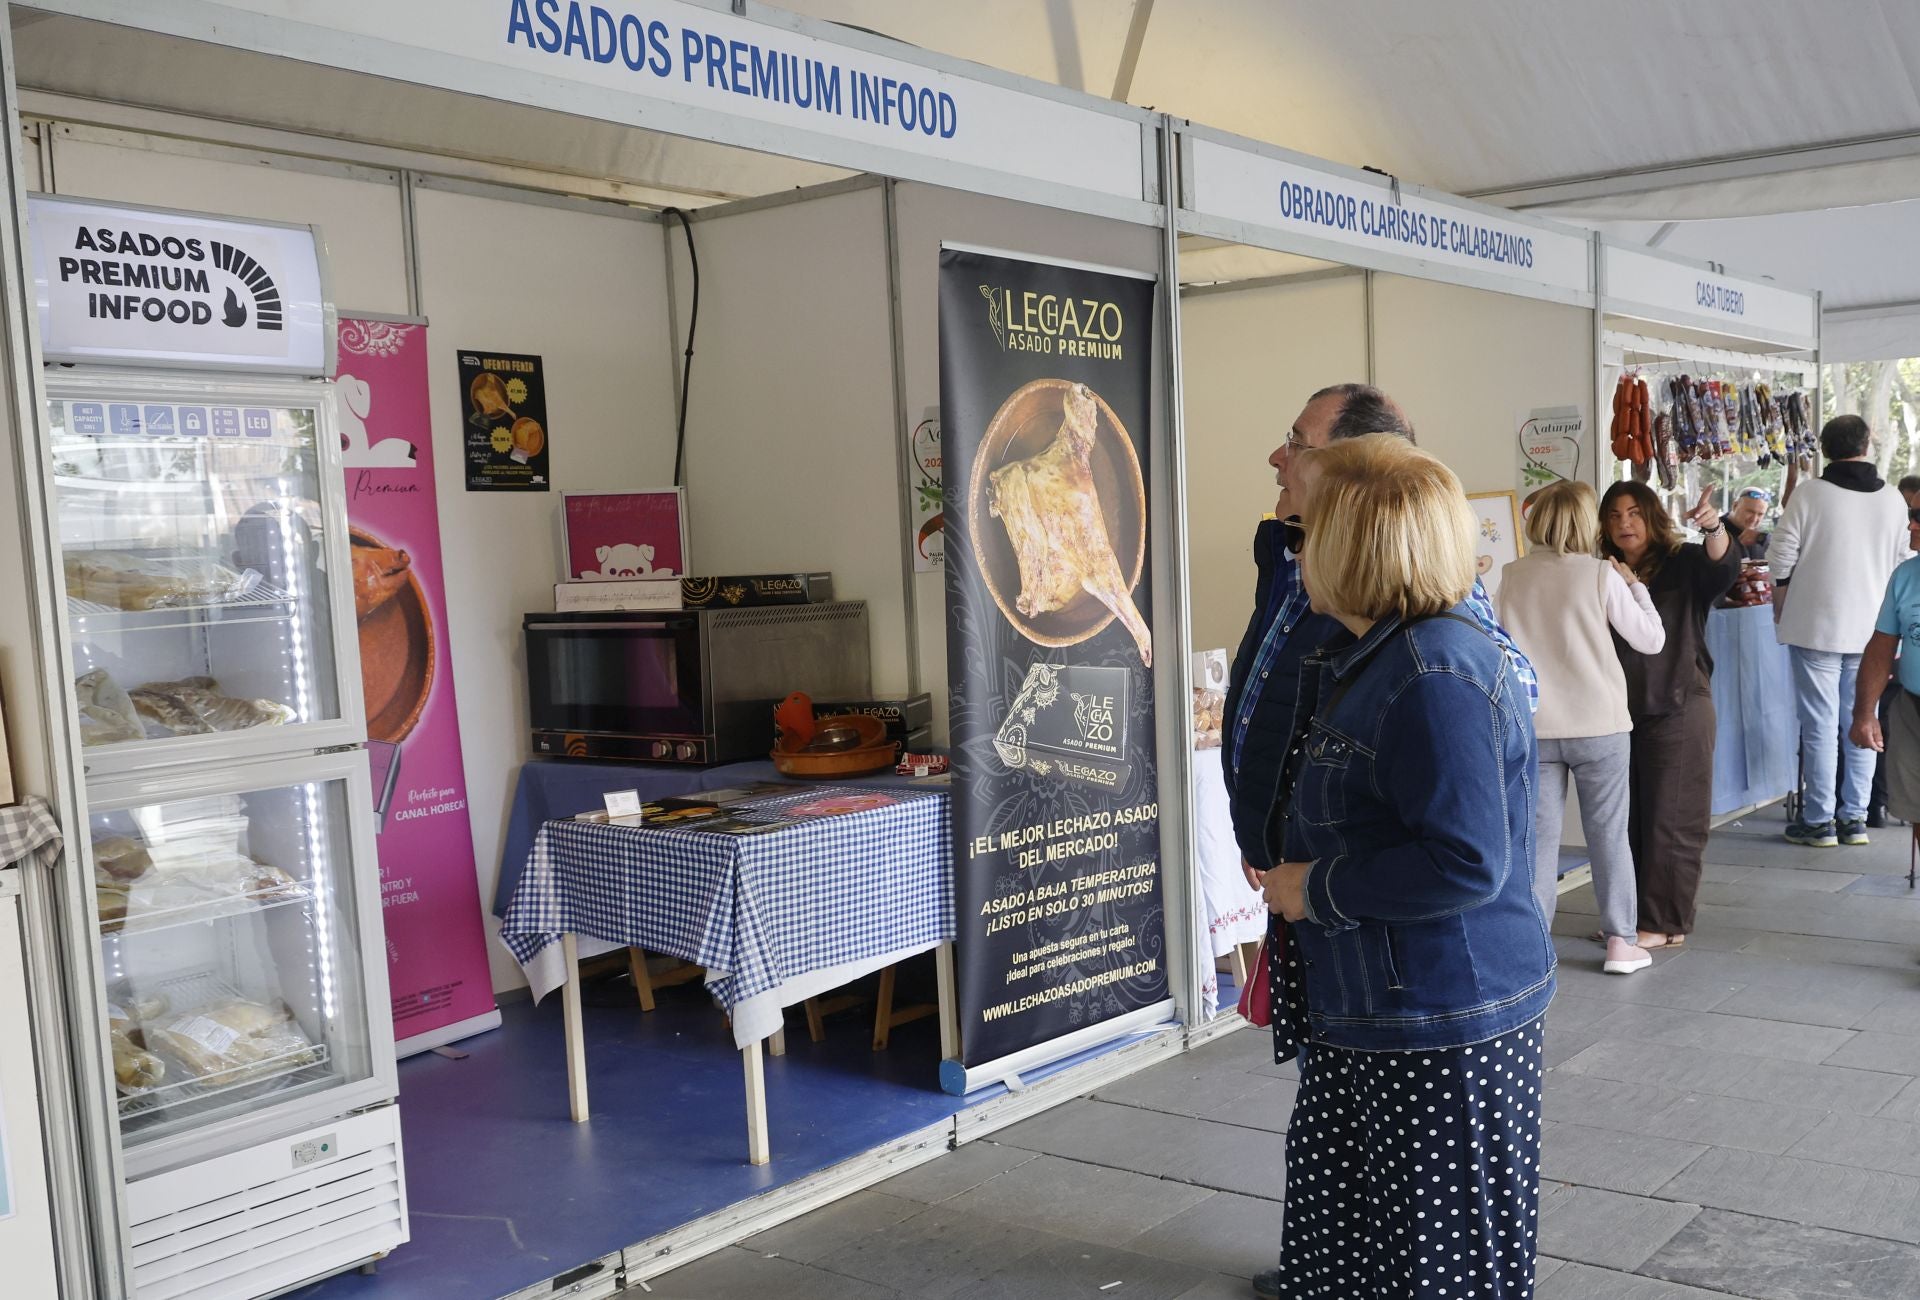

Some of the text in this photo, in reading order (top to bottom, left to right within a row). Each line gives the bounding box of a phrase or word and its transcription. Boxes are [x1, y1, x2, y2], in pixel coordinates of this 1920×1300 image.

[506, 0, 957, 139] ASADOS PREMIUM INFOOD
[1280, 180, 1533, 269] OBRADOR CLARISAS DE CALABAZANOS
[75, 226, 205, 261] ASADOS
[59, 256, 210, 293] PREMIUM
[89, 293, 212, 325] INFOOD
[1696, 281, 1744, 315] CASA TUBERO
[1008, 333, 1122, 360] ASADO PREMIUM
[74, 415, 103, 424] CAPACITY
[247, 416, 268, 430] LED
[1529, 446, 1551, 455] 2025
[354, 469, 422, 500] Premium
[1091, 695, 1114, 710] LE
[1062, 738, 1117, 753] ASADO PREMIUM
[1086, 724, 1113, 741] ZO
[395, 807, 429, 821] CANAL
[969, 803, 1158, 859] ¡EL MEJOR LECHAZO ASADO
[1019, 832, 1118, 869] DEL MERCADO!
[391, 891, 419, 906] FUERA
[406, 877, 412, 887] Y
[981, 862, 1156, 915] ASADO A BAJA TEMPERATURA
[986, 880, 1153, 936] ¡LISTO EN SOLO 30 MINUTOS!
[1006, 935, 1135, 985] ¡Ideal para celebraciones y regalo!
[1013, 924, 1129, 964] Una apuesta segura en tu carta
[983, 959, 1156, 1022] WWW.LECHAZOASADOPREMIUM.COM
